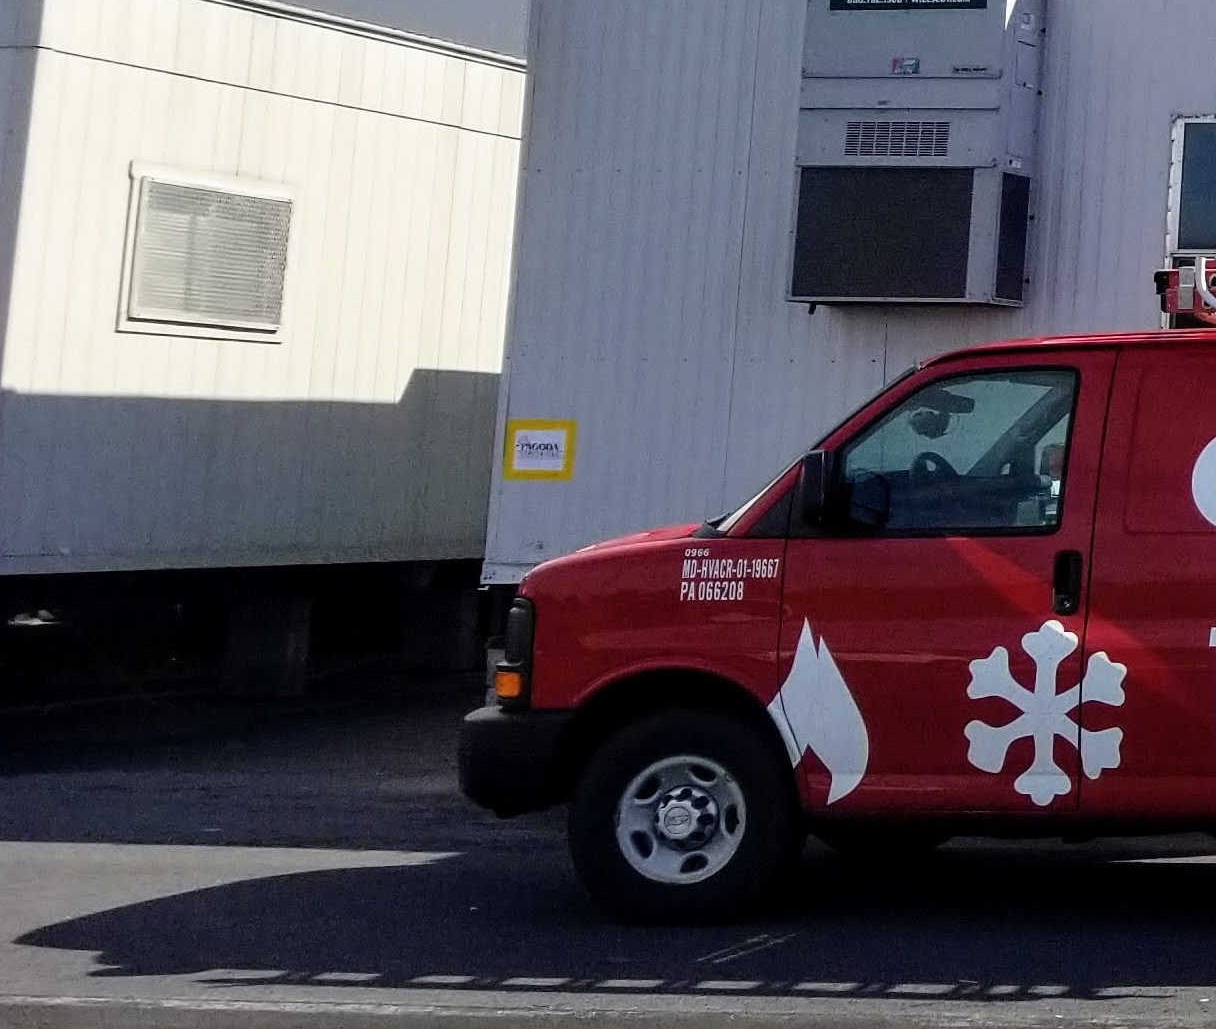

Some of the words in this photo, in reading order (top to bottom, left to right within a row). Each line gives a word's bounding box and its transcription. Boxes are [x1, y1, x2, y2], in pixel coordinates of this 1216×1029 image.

[682, 558, 780, 579] MD-HVACR-01-19667
[680, 581, 696, 601] PA
[698, 581, 745, 601] 066208
